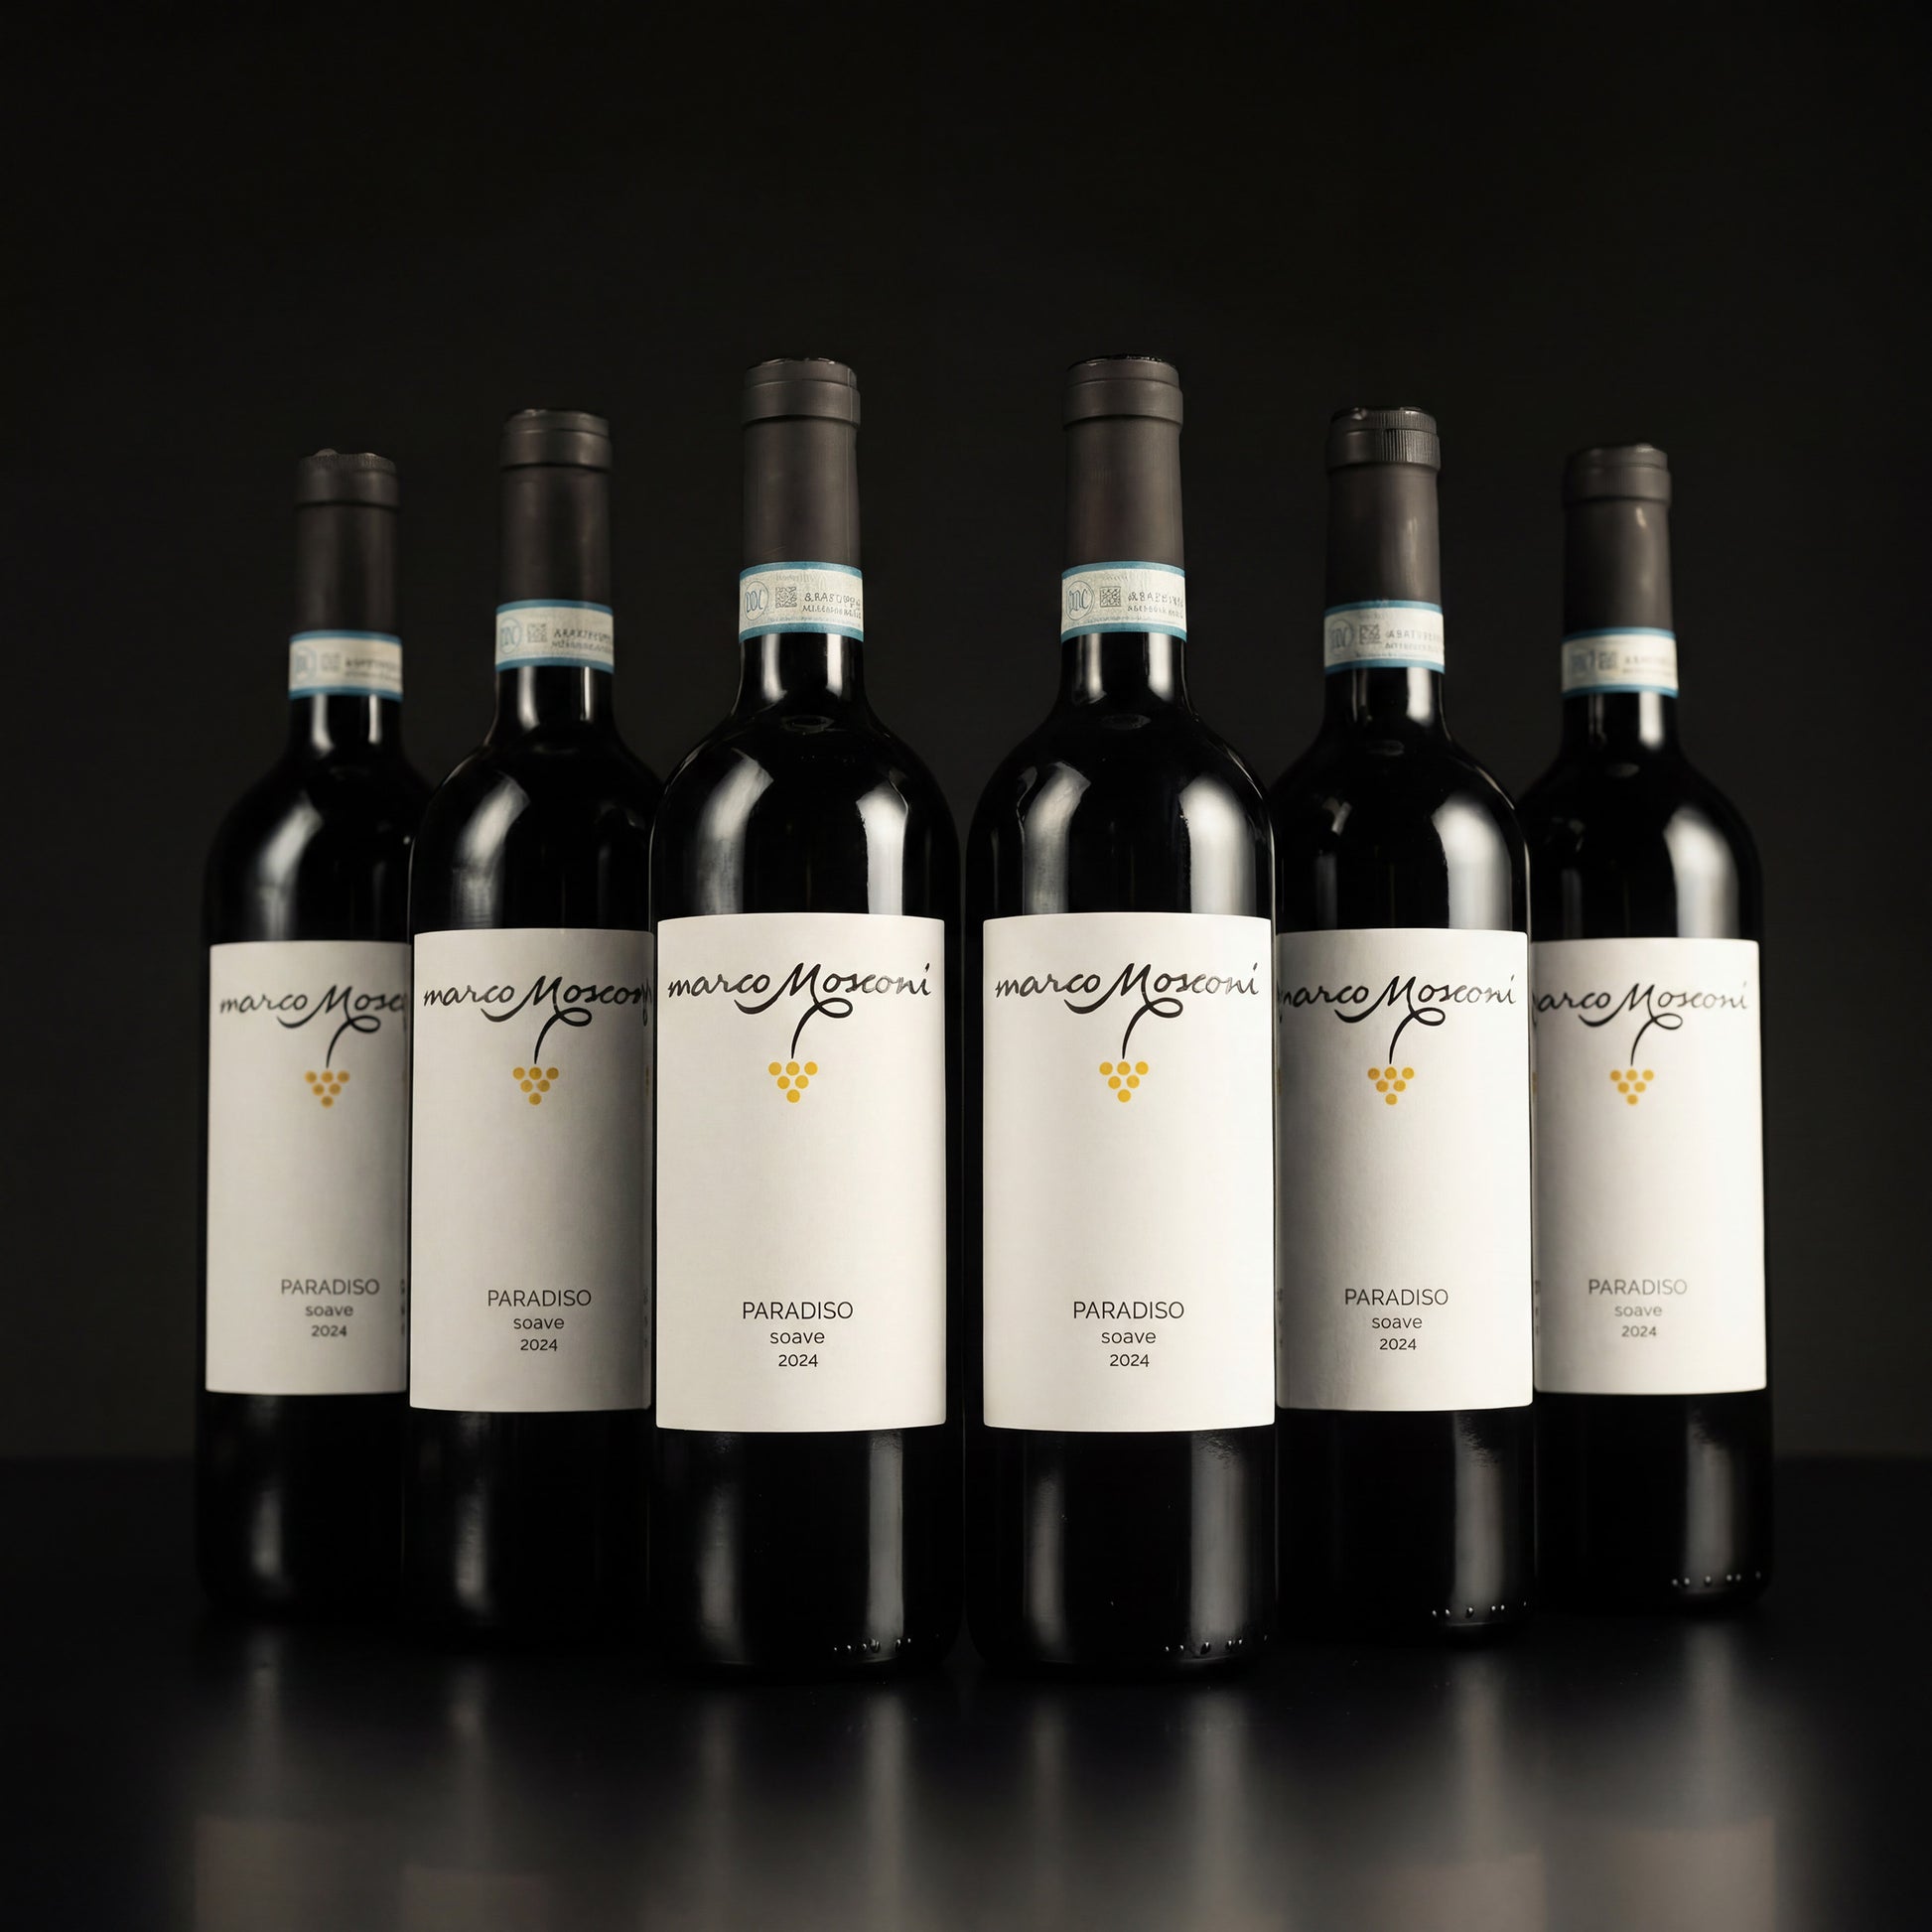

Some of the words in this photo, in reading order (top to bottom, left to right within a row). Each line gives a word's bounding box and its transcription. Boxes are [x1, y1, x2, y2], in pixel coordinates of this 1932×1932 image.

[423, 984, 515, 1006] marco
[668, 973, 770, 998] marco
[734, 962, 931, 1019] Mosconi
[996, 973, 1101, 998] marco
[1064, 963, 1259, 1019] Mosconi
[220, 994, 308, 1013] marco
[1334, 975, 1516, 1026] Mosconi
[1538, 992, 1611, 1013] arco
[1579, 981, 1747, 1030] Mosconi
[281, 1279, 380, 1296] PARADISO
[1588, 1279, 1688, 1296] PARADISO
[487, 1289, 592, 1307] PARADISO
[1344, 1289, 1449, 1307] PARADISO
[305, 1305, 353, 1316] soave
[744, 1301, 853, 1319] PARADISO
[1074, 1301, 1184, 1319] PARADISO
[1614, 1306, 1663, 1316] soave
[311, 1324, 347, 1337] 2024
[513, 1317, 565, 1329] soave
[1371, 1317, 1423, 1329] soave
[770, 1332, 825, 1344] soave
[1101, 1331, 1157, 1344] soave
[1621, 1325, 1657, 1337] 2024
[520, 1338, 558, 1351] 2024
[1379, 1338, 1417, 1350] 2024
[778, 1353, 818, 1367] 2024
[1109, 1353, 1150, 1367] 2024
